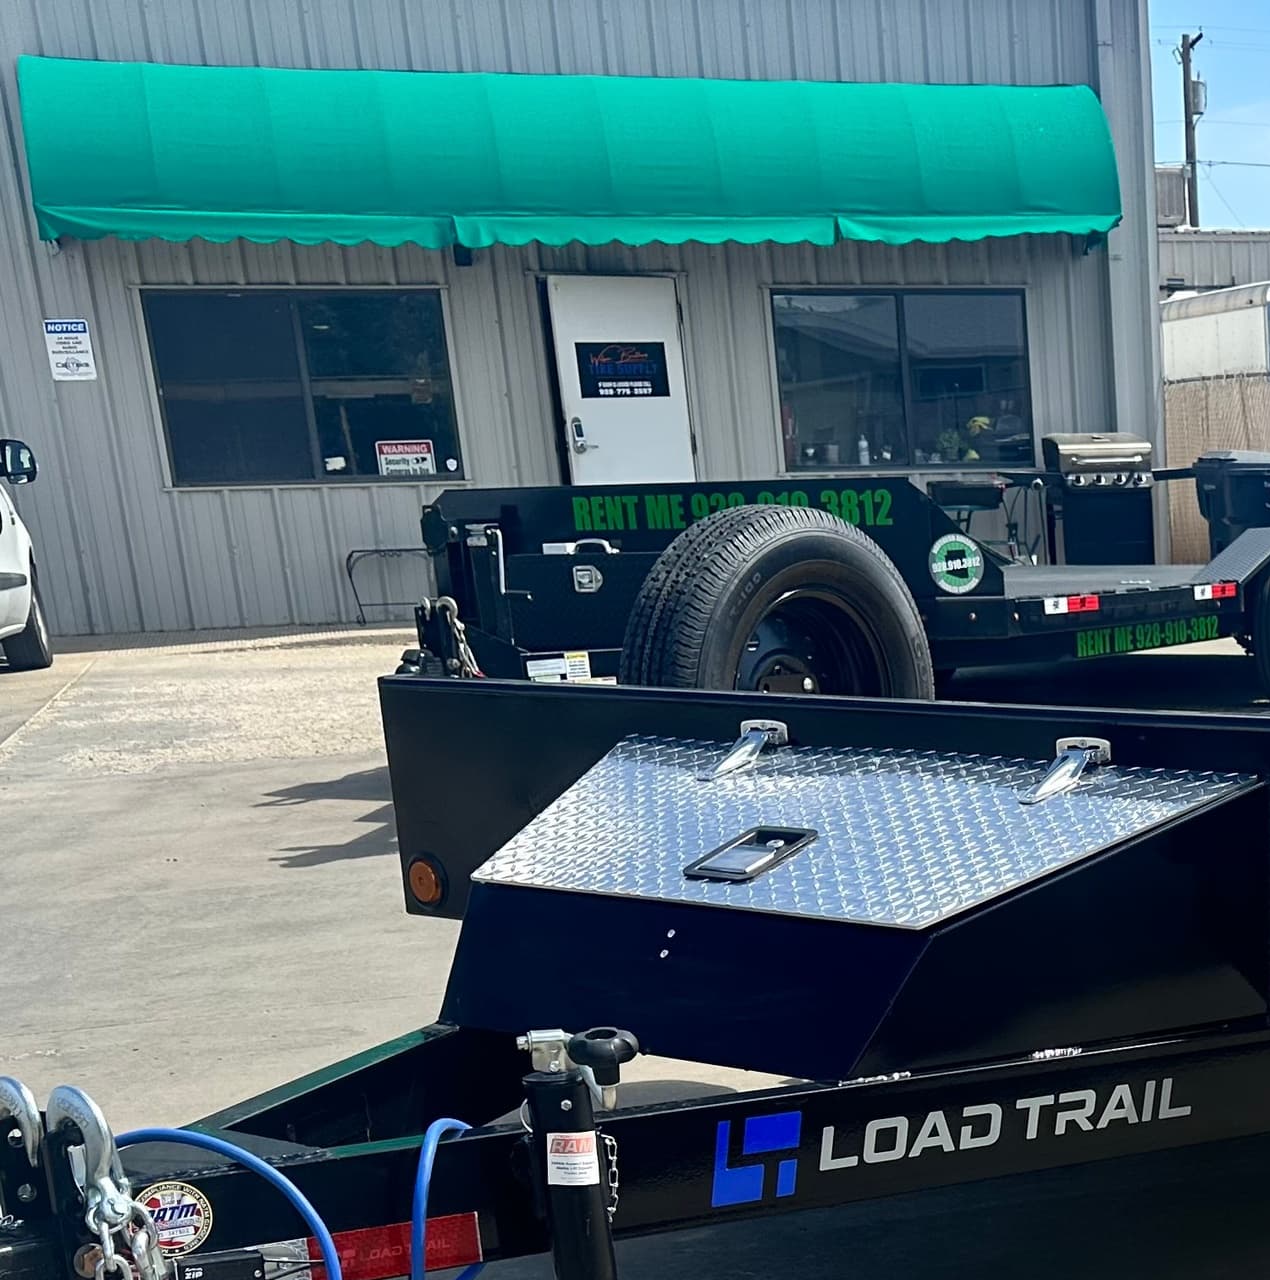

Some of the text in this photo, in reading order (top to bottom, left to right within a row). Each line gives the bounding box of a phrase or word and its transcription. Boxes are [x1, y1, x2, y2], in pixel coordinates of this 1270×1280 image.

[47, 323, 84, 331] NOTICE
[382, 444, 427, 453] WARNING
[385, 457, 409, 466] Security
[572, 495, 638, 530] RENT
[644, 493, 686, 530] ME
[1077, 615, 1218, 657] RENT ME 928-910-3812
[819, 1078, 1192, 1171] LOAD TRAIL
[552, 1139, 593, 1153] RAM
[404, 1239, 451, 1255] TAIL
